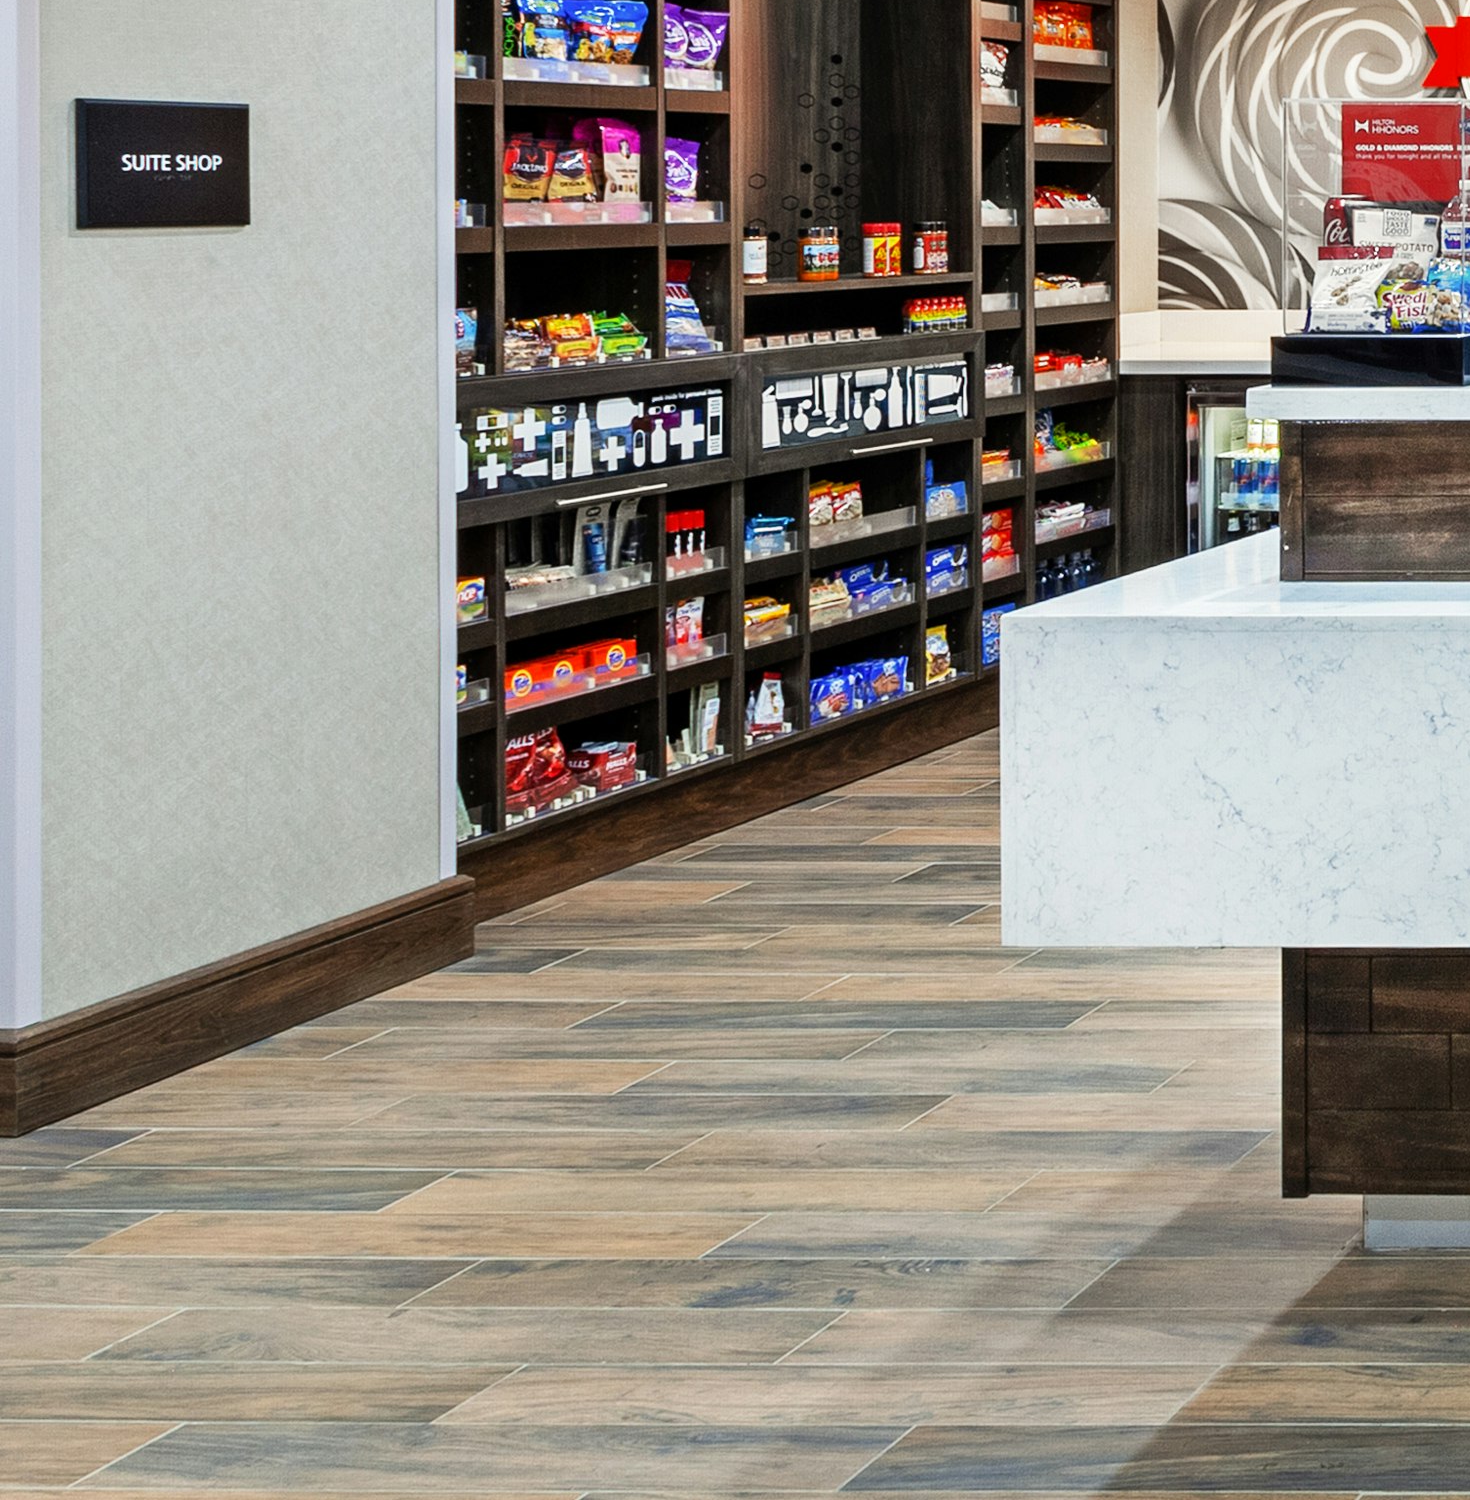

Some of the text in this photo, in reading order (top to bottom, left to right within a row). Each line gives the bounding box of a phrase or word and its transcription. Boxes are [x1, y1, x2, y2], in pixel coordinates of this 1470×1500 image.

[1372, 125, 1419, 134] HHONORS
[121, 154, 222, 171] SUITE SHOP
[1386, 221, 1410, 229] TASTE
[1385, 228, 1410, 236] GOOD
[1395, 243, 1434, 253] POTATO
[1383, 291, 1427, 304] Swedi
[506, 733, 535, 750] ALLS
